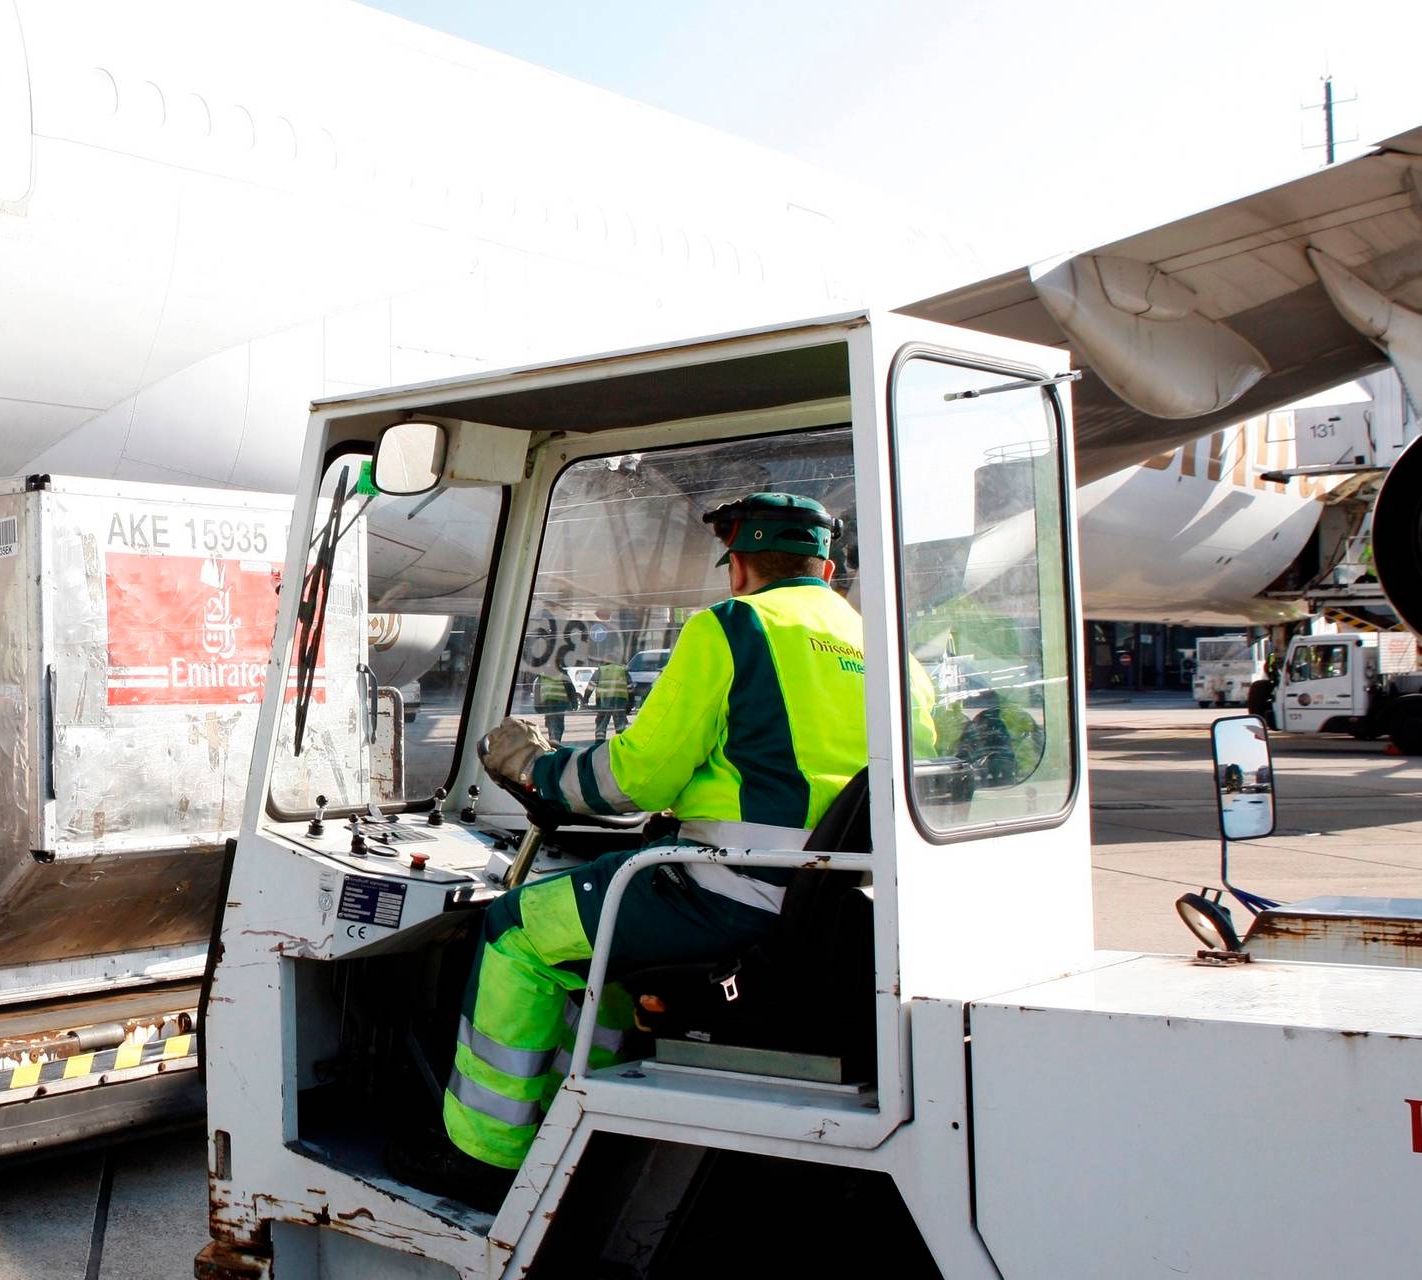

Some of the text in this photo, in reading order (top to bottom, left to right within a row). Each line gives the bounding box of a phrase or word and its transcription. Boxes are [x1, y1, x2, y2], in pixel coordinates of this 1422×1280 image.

[1309, 423, 1336, 439] 131
[107, 512, 171, 549] AKE
[184, 517, 268, 554] 15935
[169, 656, 269, 689] Emirates
